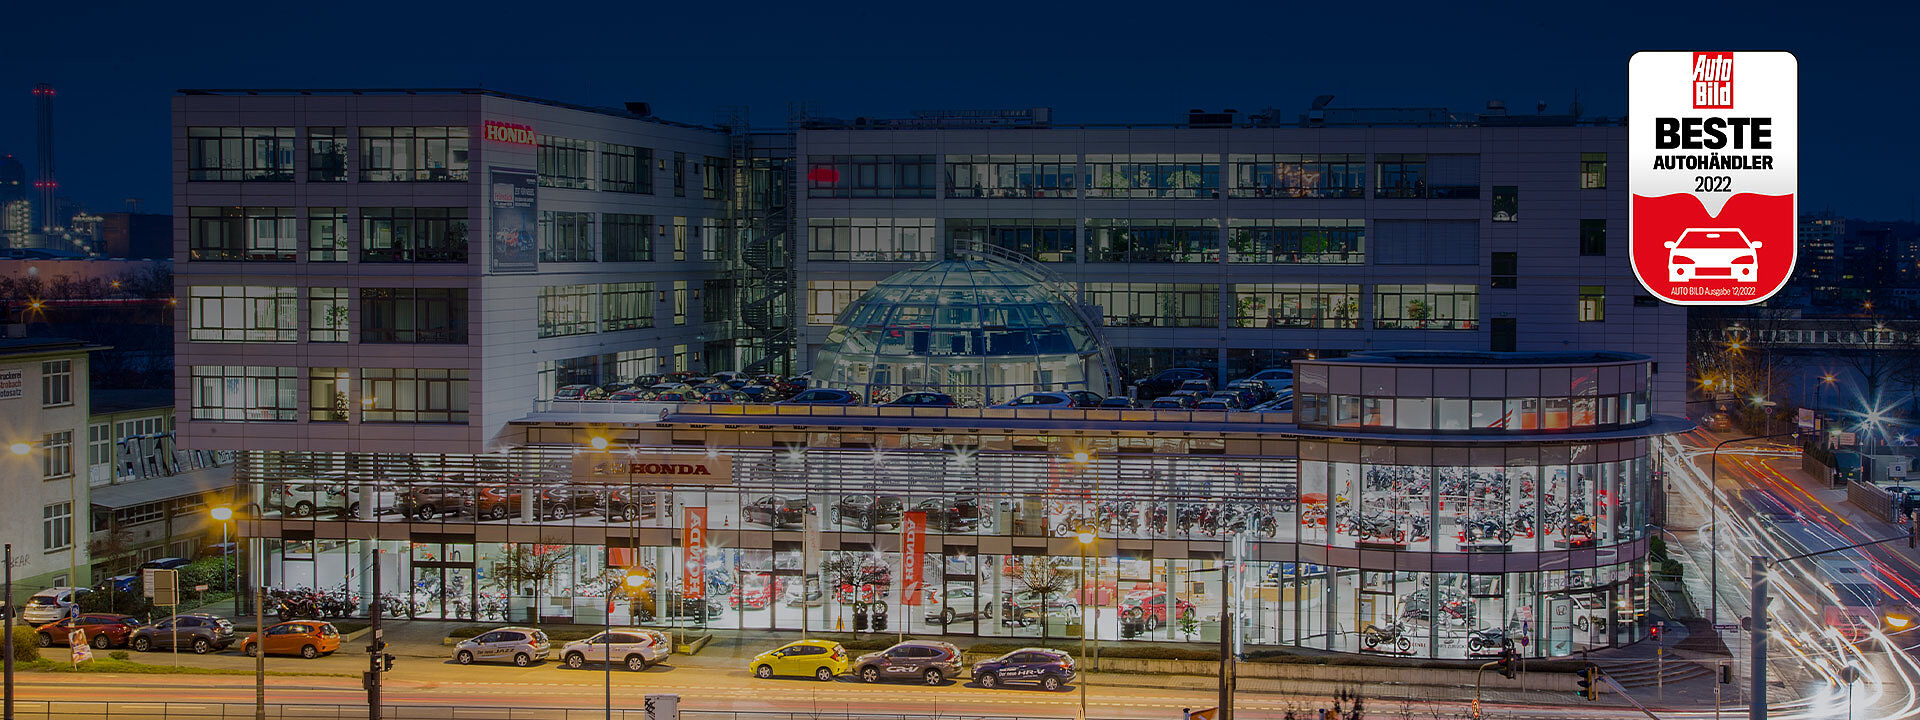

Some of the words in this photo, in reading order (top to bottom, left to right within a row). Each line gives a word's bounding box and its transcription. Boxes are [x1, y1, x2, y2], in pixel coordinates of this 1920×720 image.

[486, 124, 537, 145] HONDA
[629, 463, 711, 475] HONDA
[689, 510, 701, 594] HONDA
[905, 518, 916, 581] HONDA
